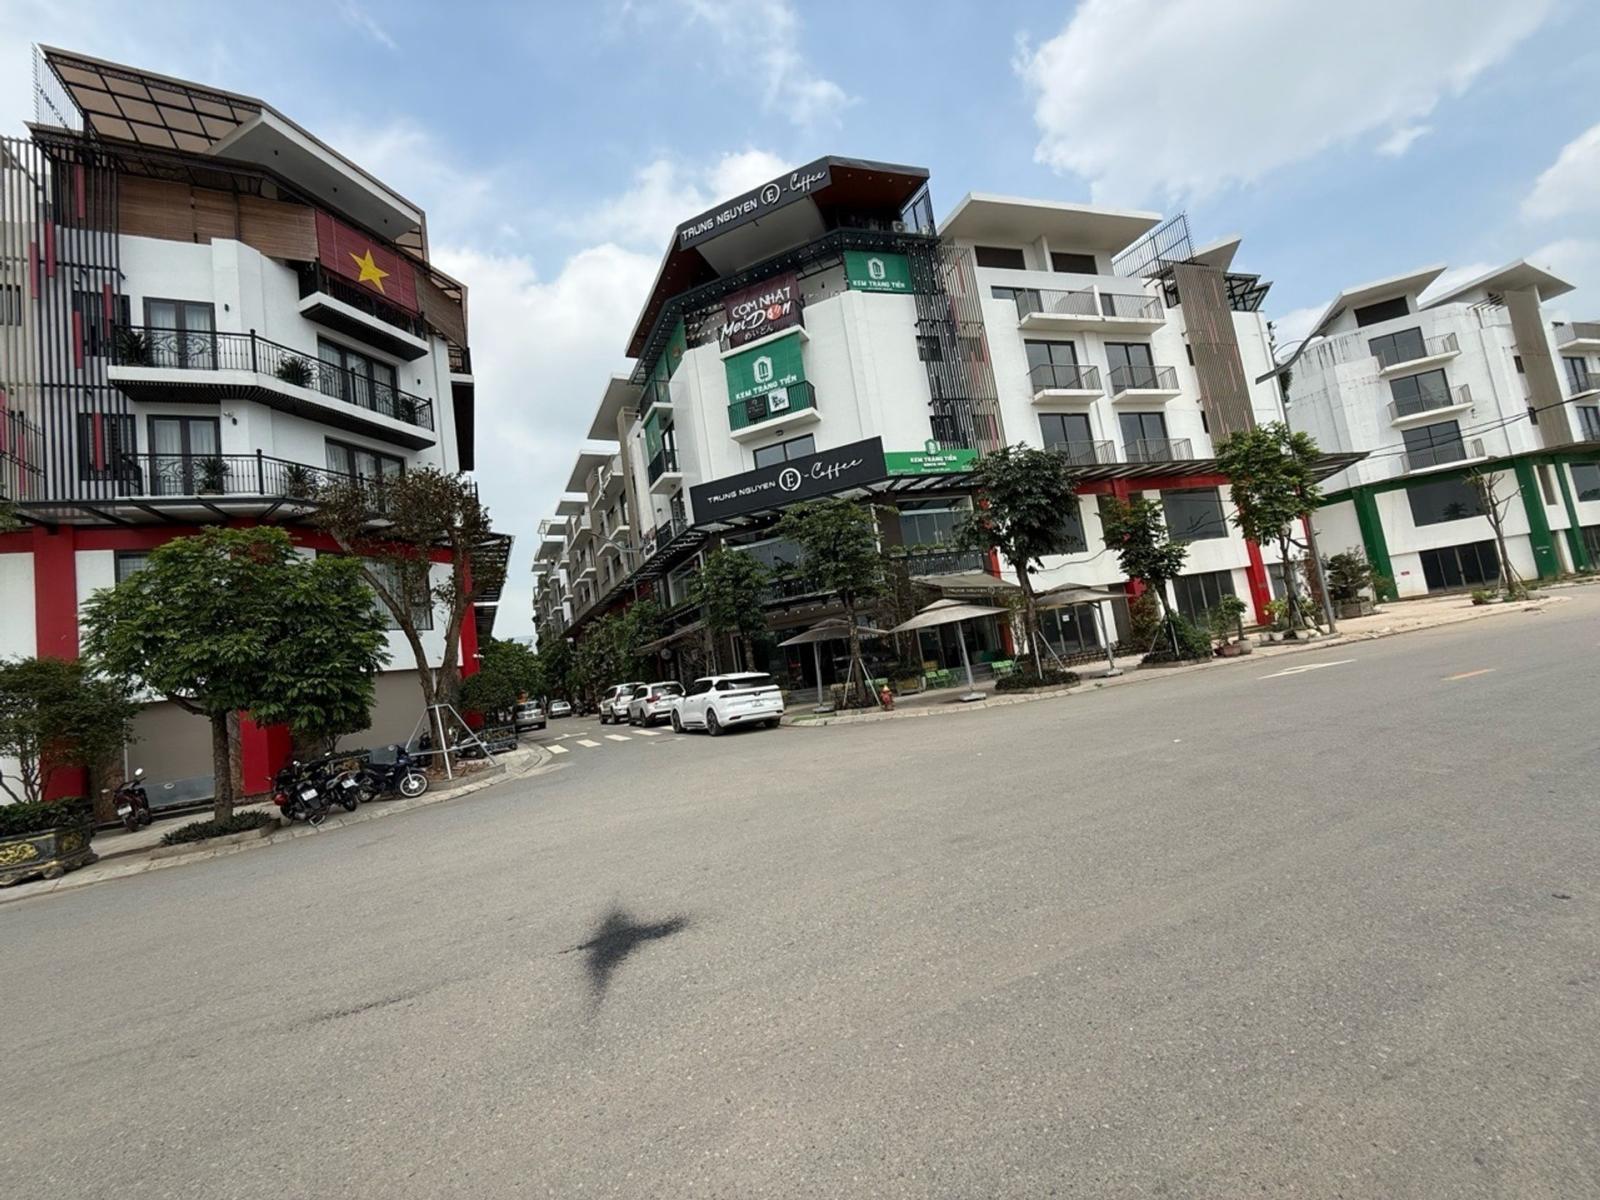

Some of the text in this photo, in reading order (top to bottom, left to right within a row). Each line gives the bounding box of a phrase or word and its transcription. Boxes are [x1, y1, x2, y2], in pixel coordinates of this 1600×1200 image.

[681, 219, 714, 241] TRUNG
[716, 199, 758, 226] NGUYEN
[735, 390, 752, 400] KEM
[707, 490, 737, 504] TRUNG
[739, 480, 776, 496] NGUYEN
[811, 458, 864, 480] Coffee
